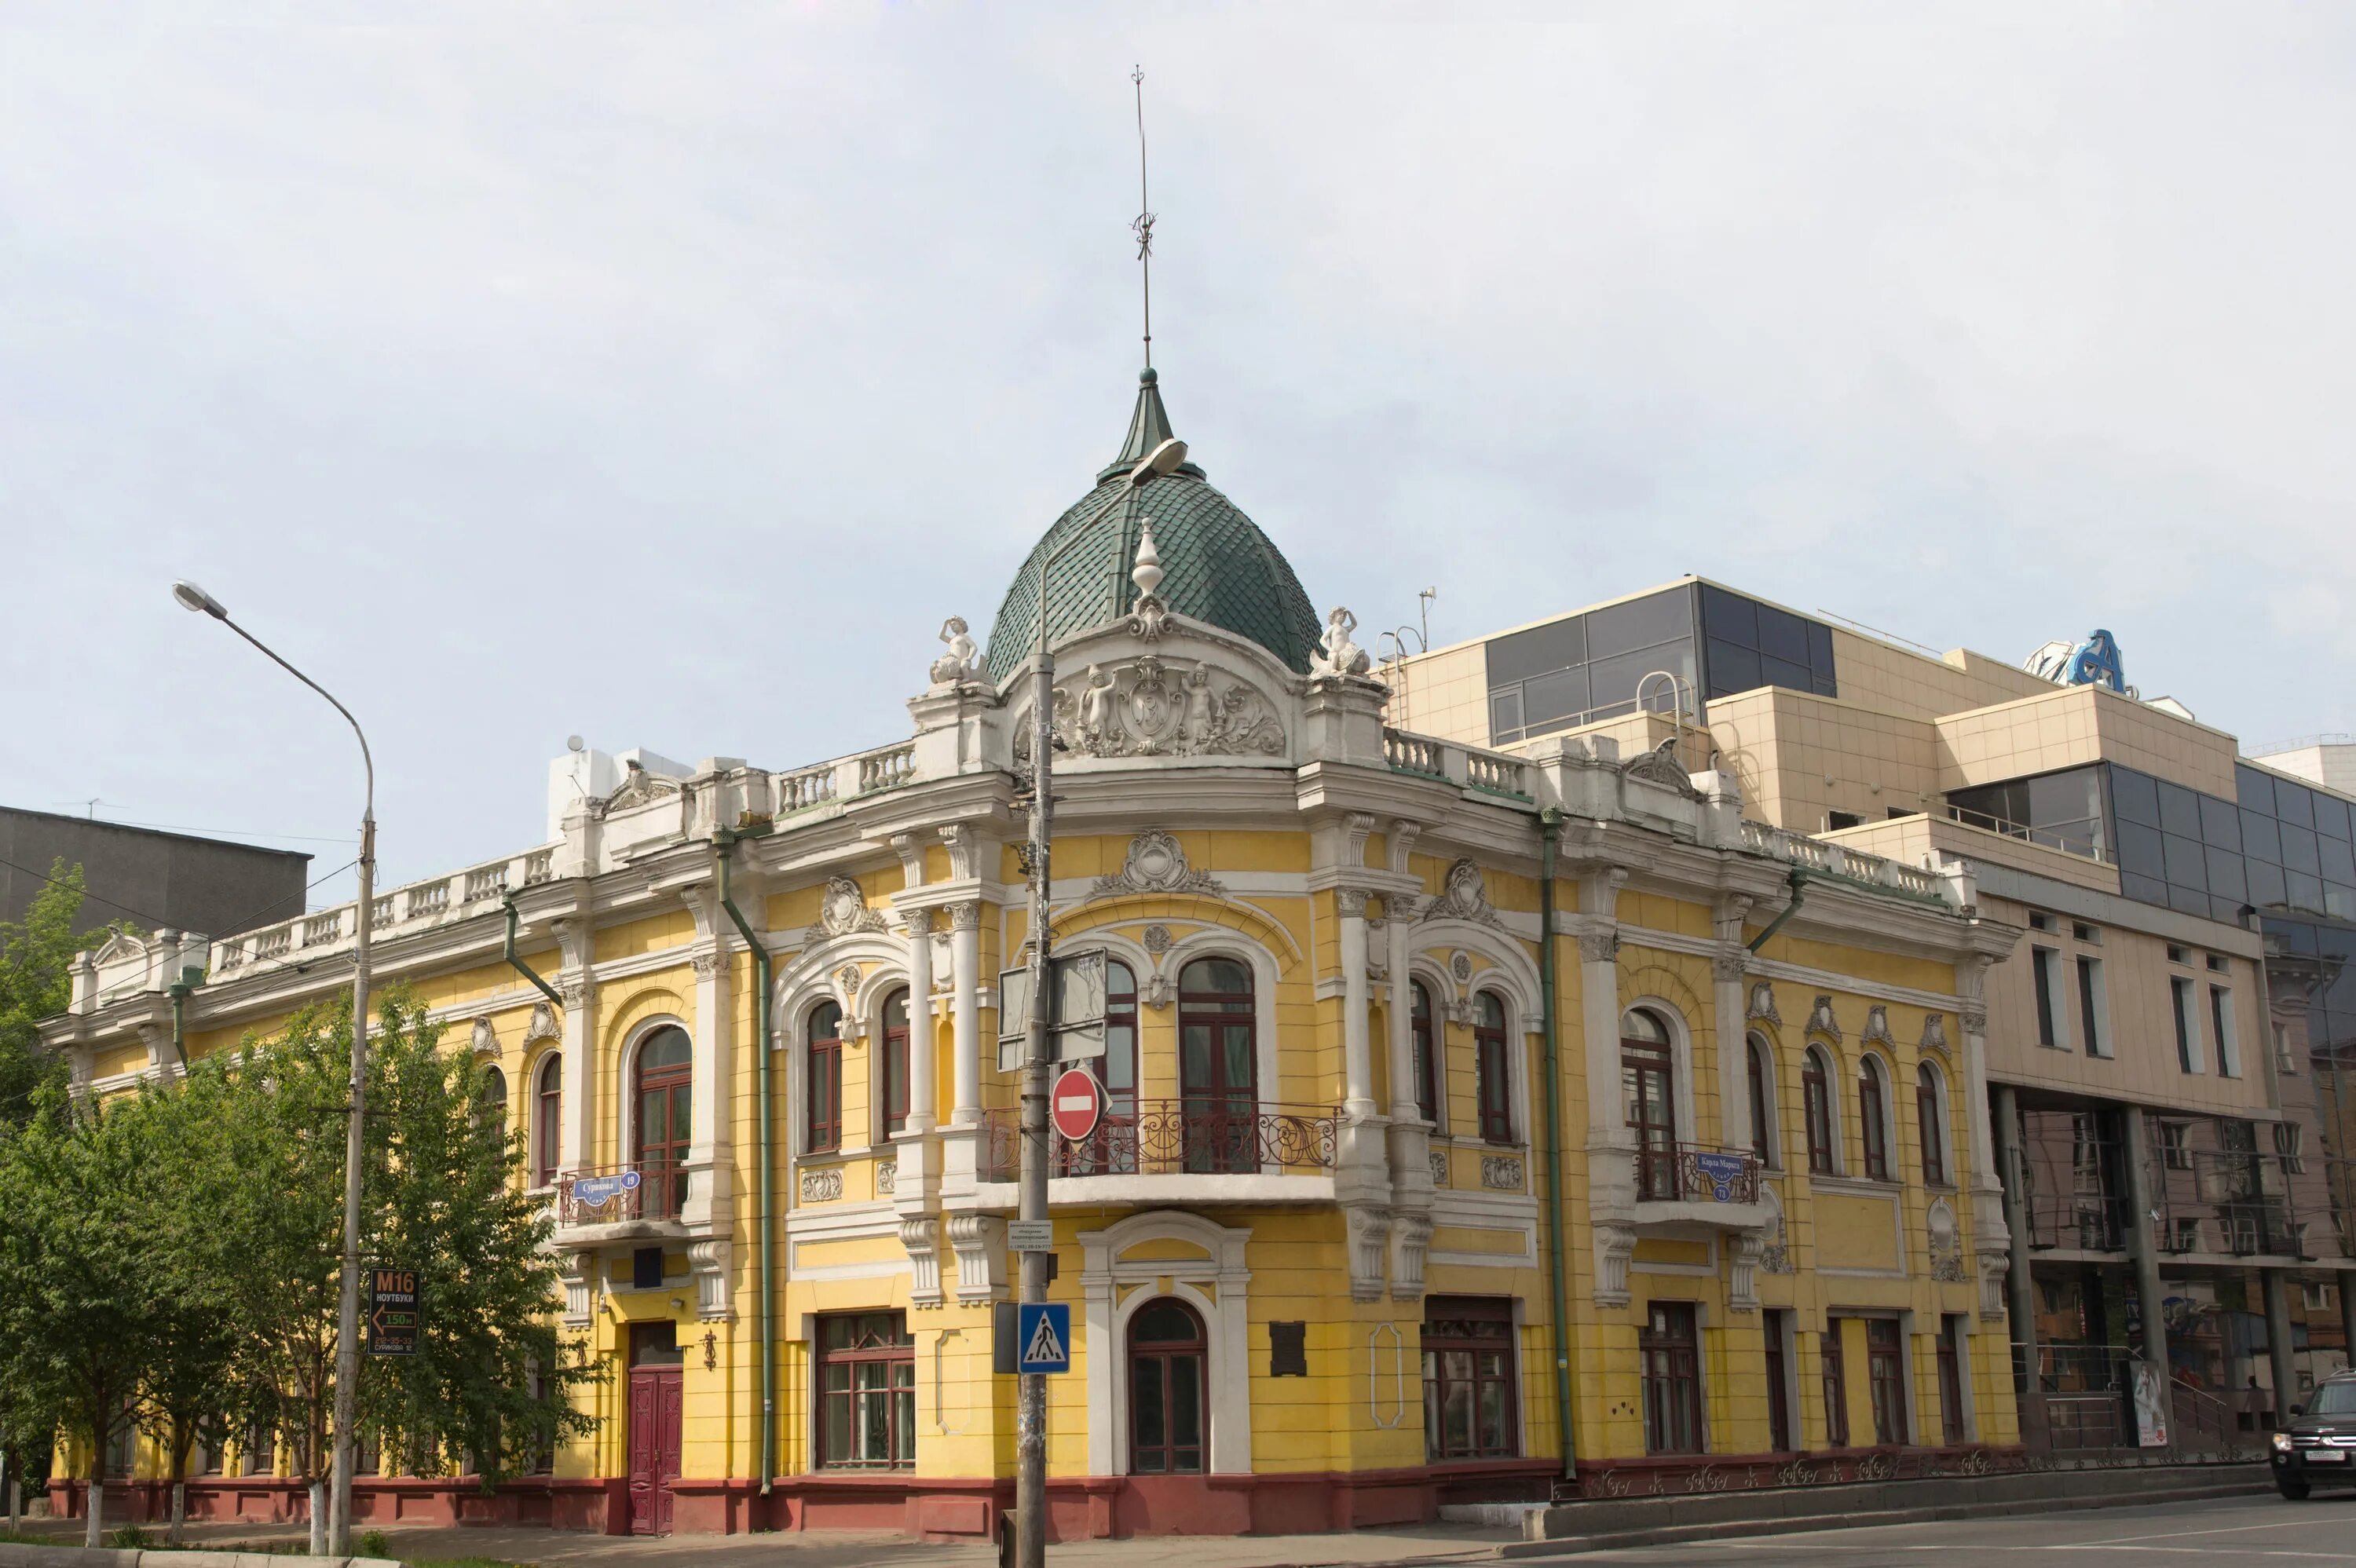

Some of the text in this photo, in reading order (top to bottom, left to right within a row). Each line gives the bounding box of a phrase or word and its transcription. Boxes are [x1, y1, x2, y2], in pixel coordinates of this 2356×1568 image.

[1701, 1157, 1740, 1170] Карла Маркса
[627, 1176, 635, 1185] 19
[583, 1182, 613, 1193] Сурикова
[1718, 1190, 1726, 1199] 73
[377, 1271, 415, 1293] М16
[376, 1294, 414, 1303] НОУТБУКИ
